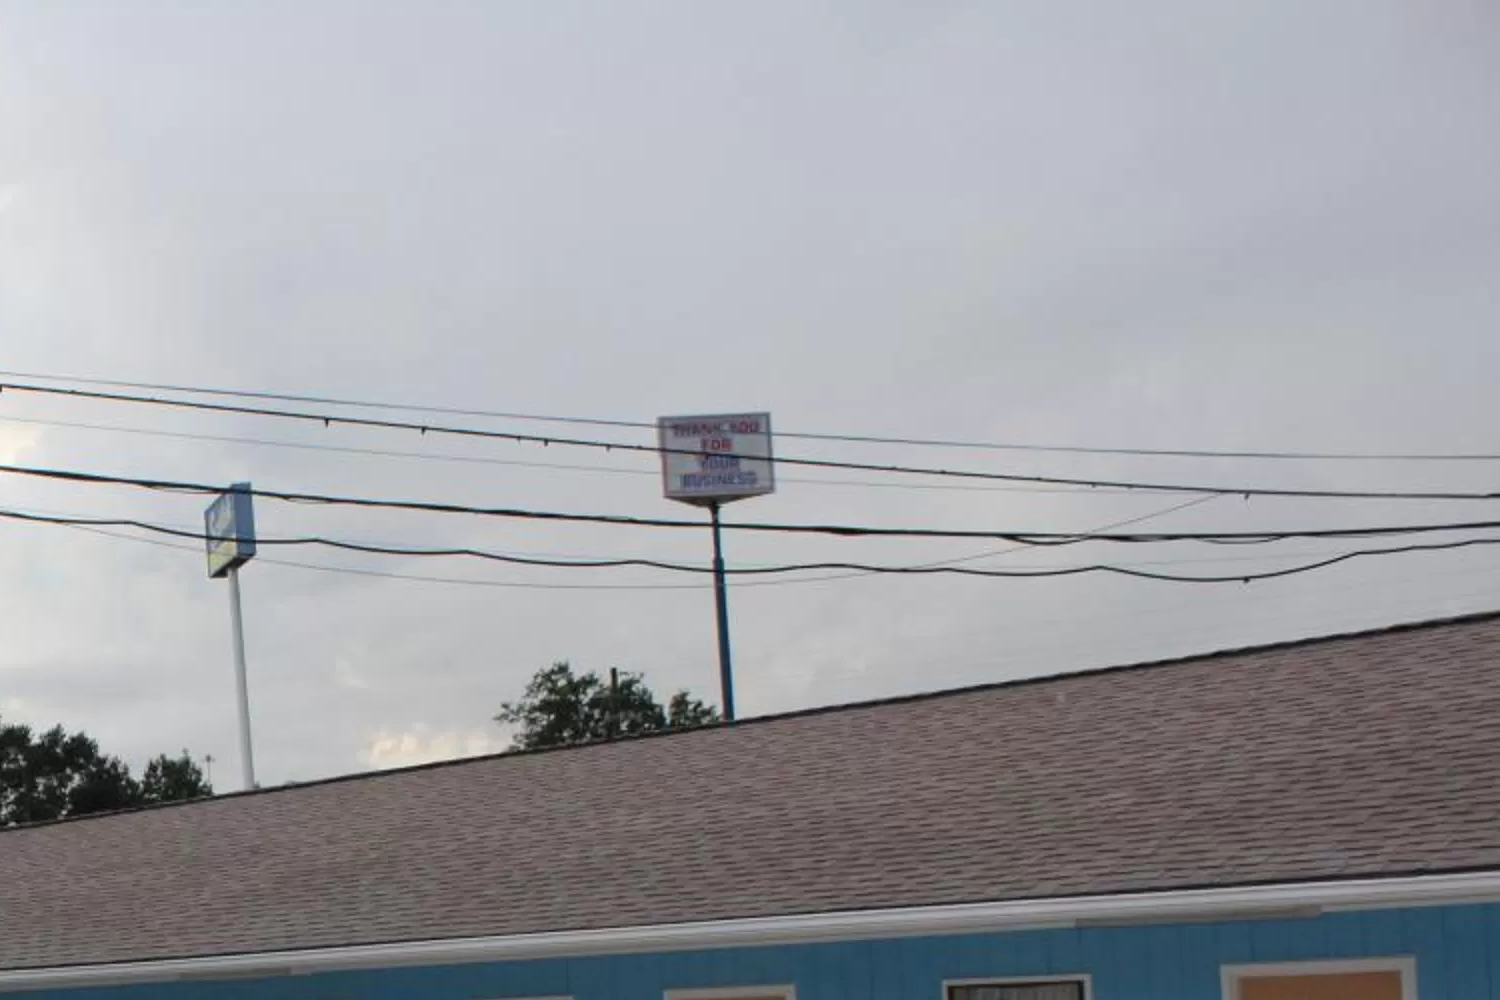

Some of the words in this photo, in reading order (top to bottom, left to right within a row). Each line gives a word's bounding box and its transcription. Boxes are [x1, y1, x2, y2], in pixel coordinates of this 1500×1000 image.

[673, 422, 722, 437] THANK
[727, 419, 760, 433] YOU
[701, 438, 733, 451] FOR
[701, 455, 740, 469] YOUR
[683, 471, 758, 488] BUSINESS
